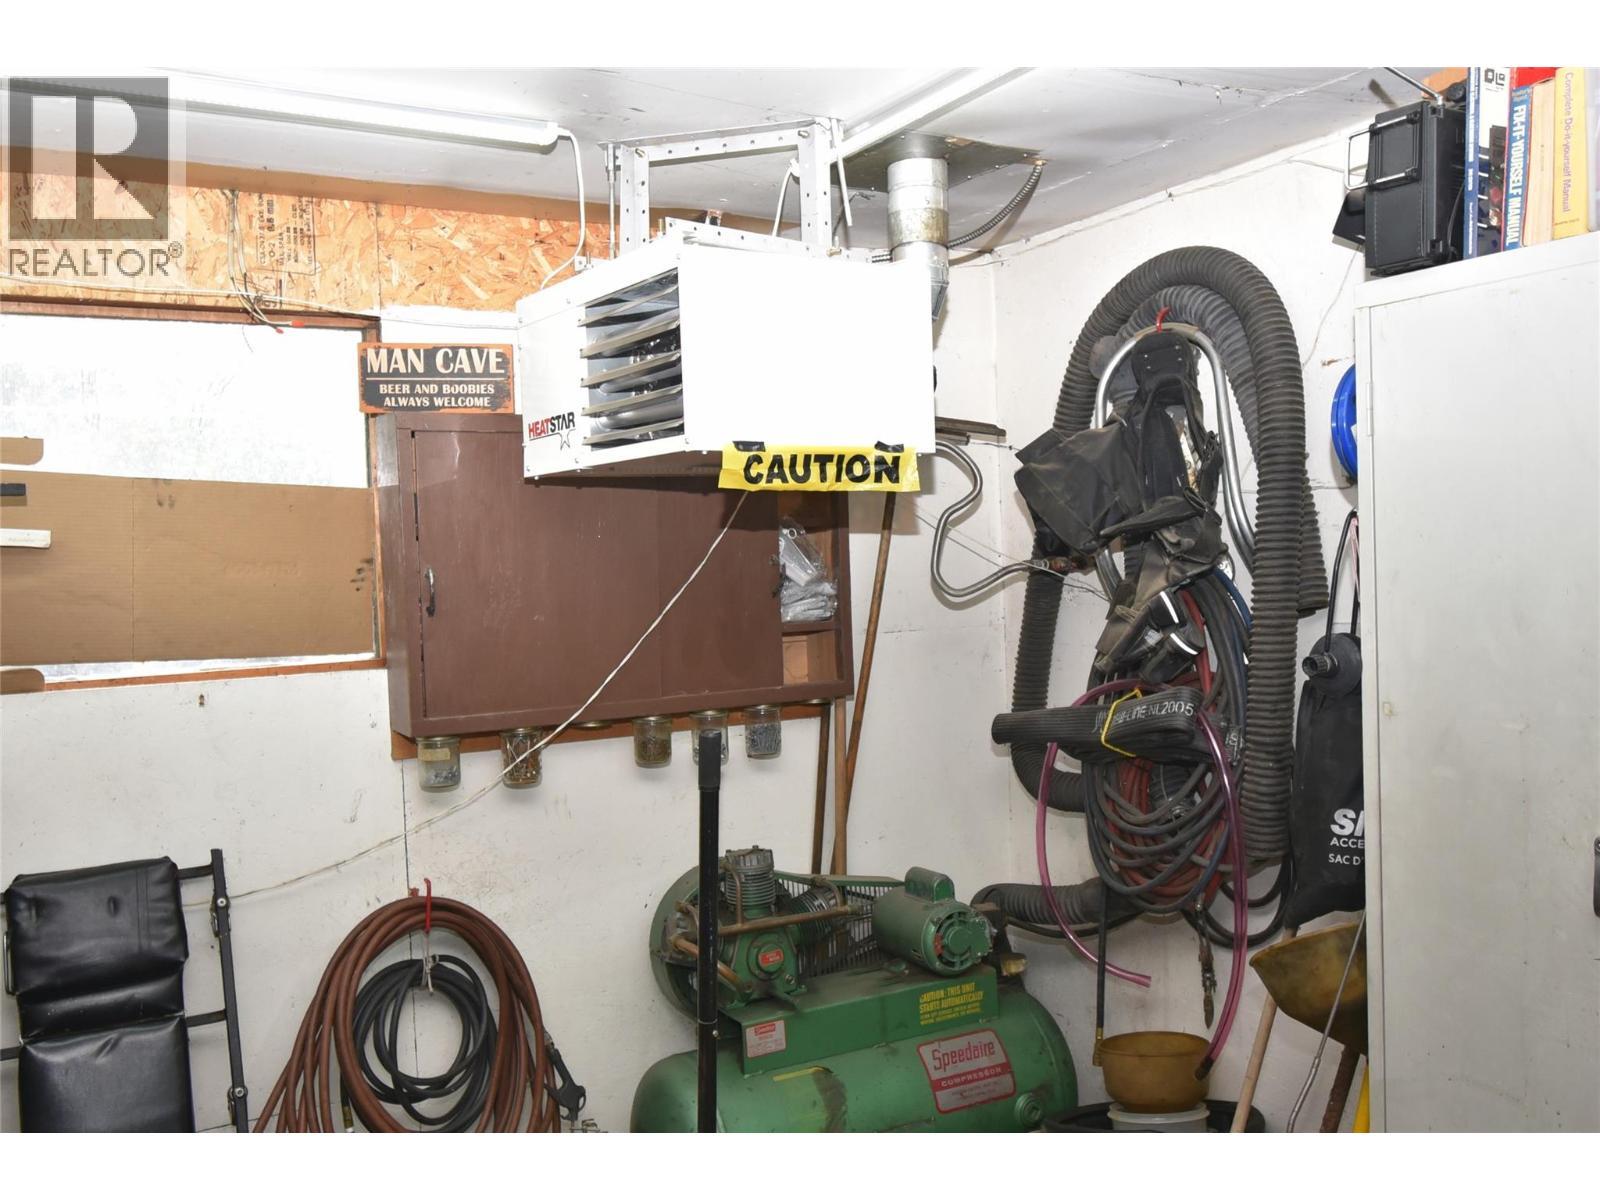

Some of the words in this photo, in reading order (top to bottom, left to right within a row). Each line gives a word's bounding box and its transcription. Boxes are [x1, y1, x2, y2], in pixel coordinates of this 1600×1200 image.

[1563, 72, 1574, 116] Complete
[1508, 104, 1527, 195] FIX-IT-YOURSELF
[1561, 118, 1574, 177] Do-it-yourself
[1562, 178, 1572, 213] Manual
[1505, 196, 1522, 246] MANUAL
[366, 347, 425, 374] MAN
[435, 347, 505, 374] CAVE
[379, 384, 411, 394] BEER
[414, 384, 438, 394] AND
[442, 384, 495, 394] BOOBIES
[383, 396, 430, 407] ALWAYS
[433, 396, 491, 407] WELCOME
[528, 411, 576, 438] HEATSTAR
[743, 453, 901, 484] CAUTION
[1328, 853, 1350, 865] SAC
[931, 1041, 996, 1073] Speedaire
